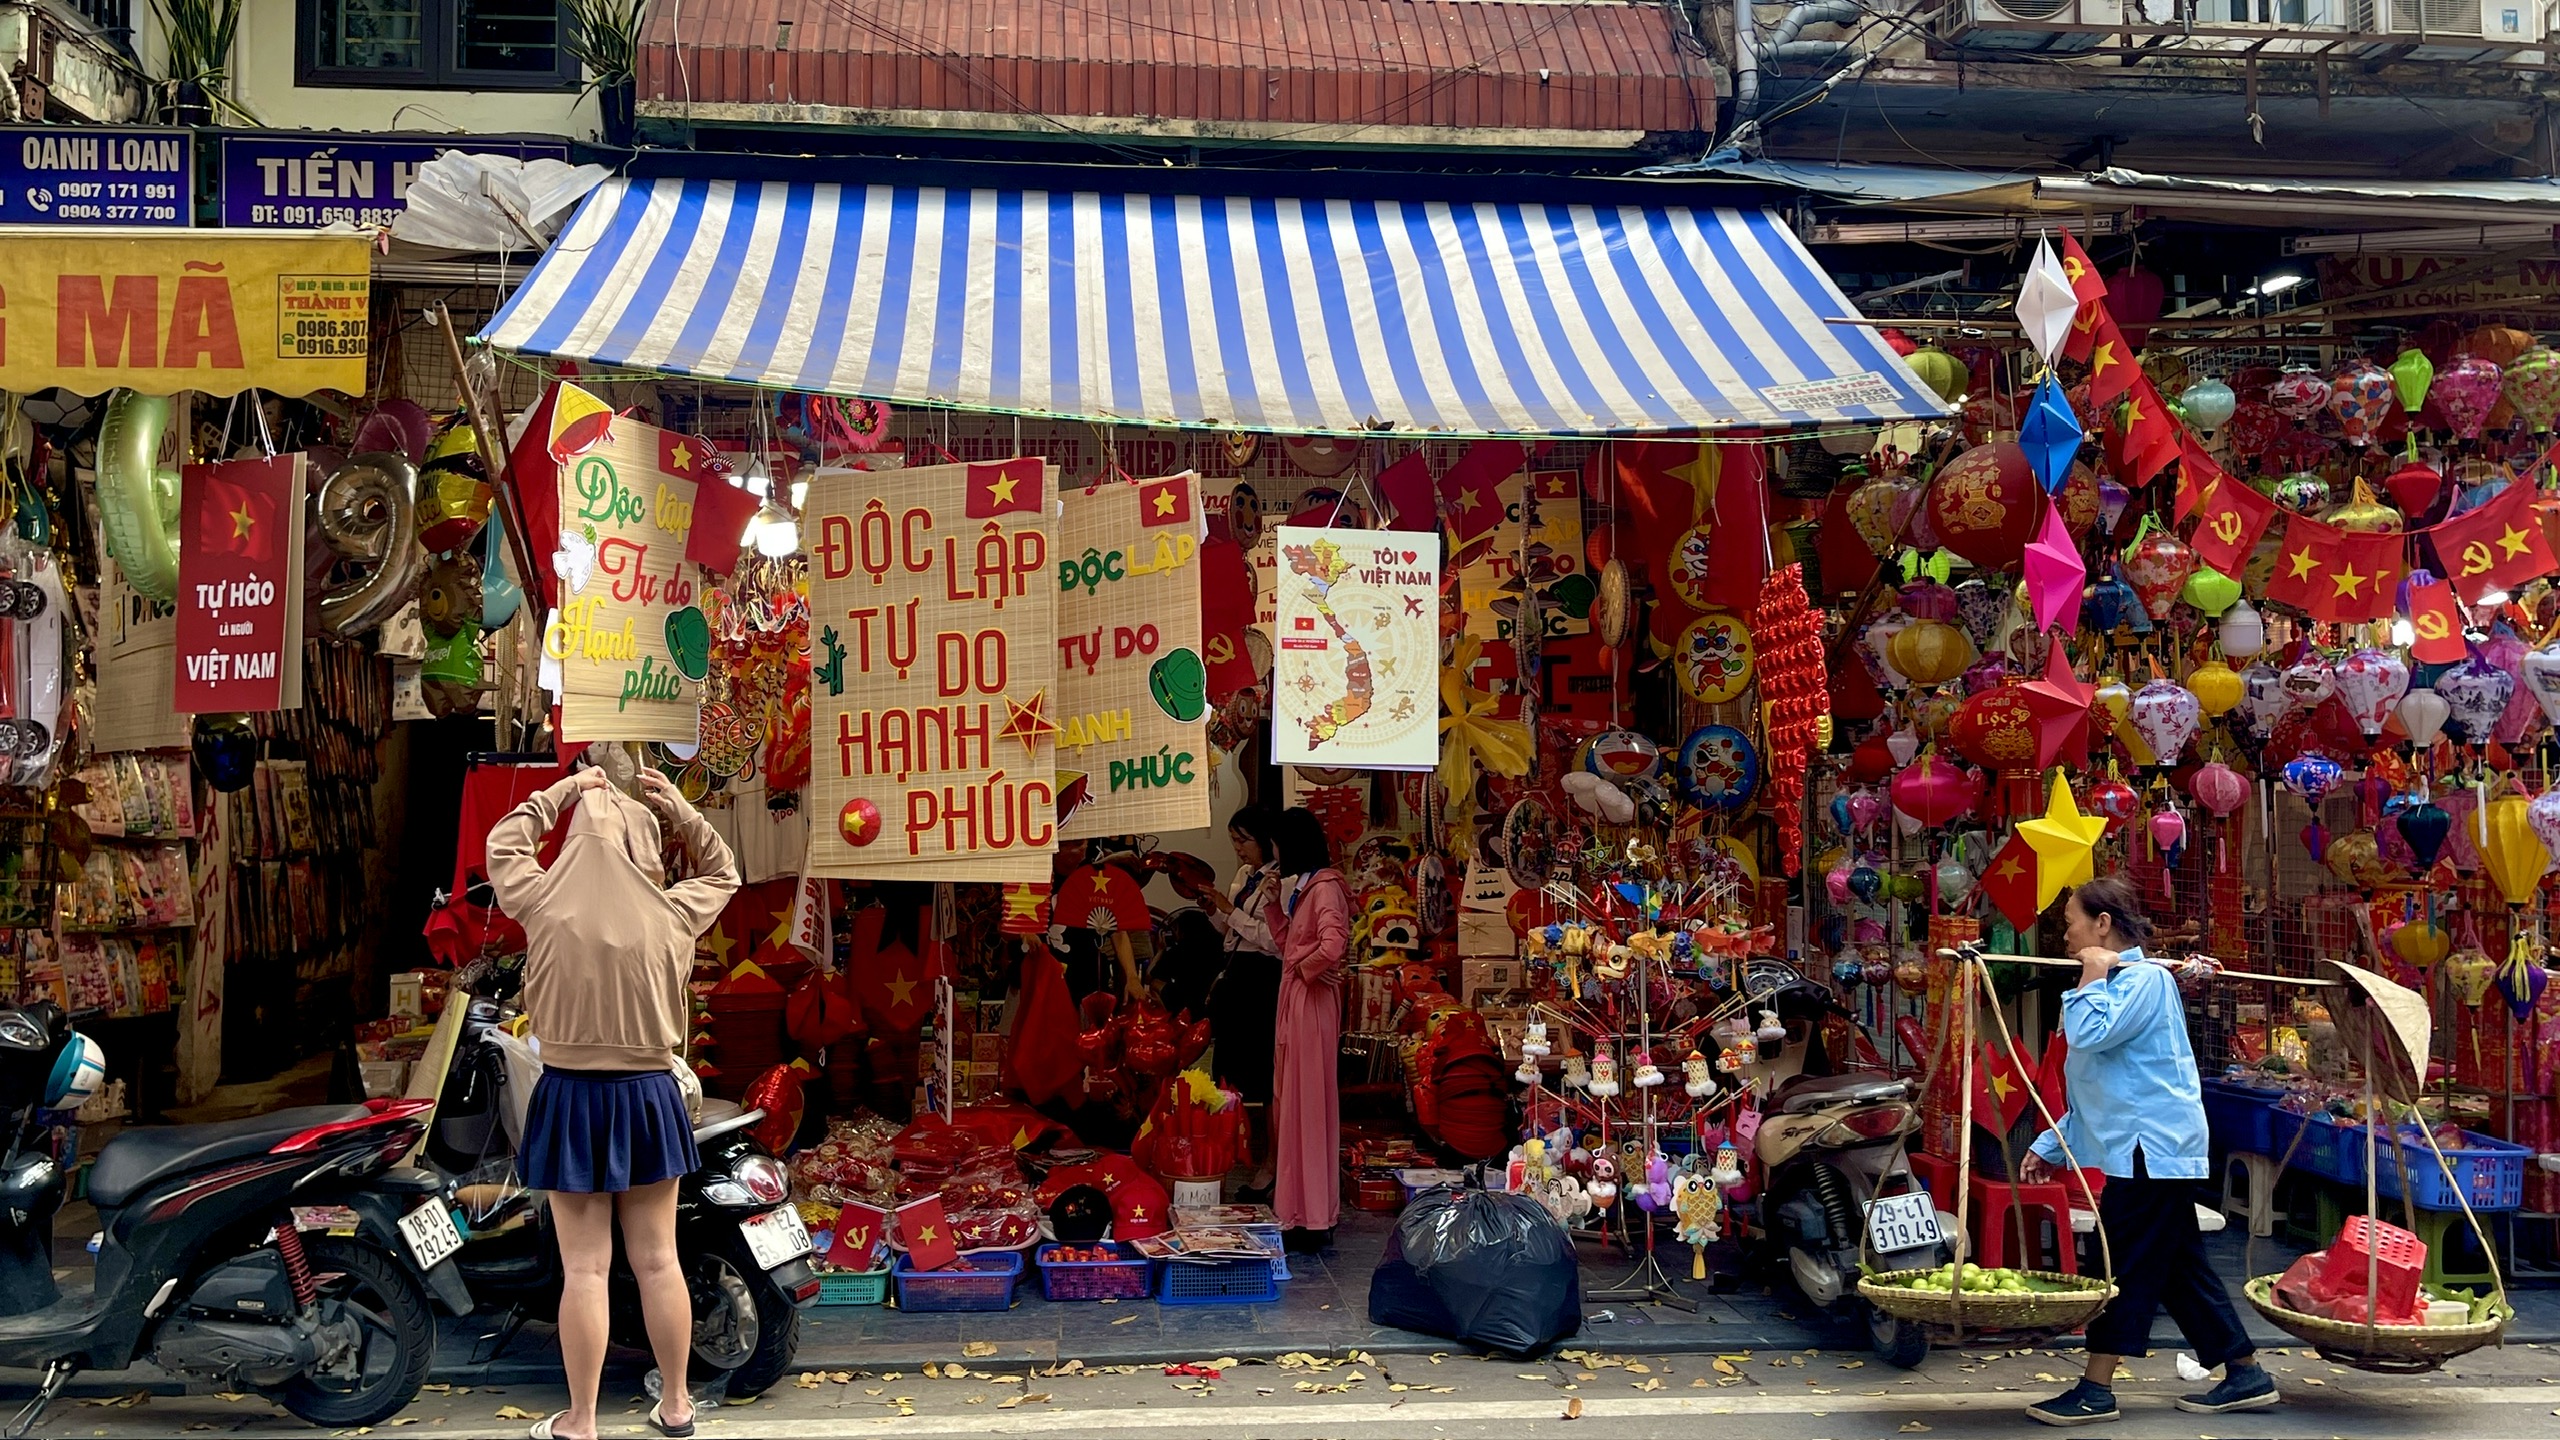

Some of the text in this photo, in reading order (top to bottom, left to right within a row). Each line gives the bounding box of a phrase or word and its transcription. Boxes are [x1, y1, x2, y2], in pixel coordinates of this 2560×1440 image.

[23, 136, 179, 172] OANH LOAN
[257, 147, 374, 199] TIẾN
[58, 182, 175, 199] 0907 171 991
[58, 205, 175, 220] 0904 377 700
[252, 205, 278, 223] ĐT:
[56, 260, 245, 369] MÃ
[285, 293, 351, 310] THÀNH
[576, 456, 692, 544] Độc lập
[599, 538, 692, 607] Tự do
[814, 498, 1047, 610] ĐỘC LẬP
[1058, 529, 1195, 596] ĐỘC LẬP
[1373, 547, 1398, 565] TÔI
[196, 579, 227, 618] TỰ
[1359, 566, 1431, 588] VIỆT NAM
[219, 622, 229, 636] LÀ
[545, 595, 638, 665] Hạnh
[848, 595, 1008, 698] TỰ DO
[1058, 623, 1159, 676] TỰ DO
[186, 648, 276, 688] VIỆT NAM
[619, 655, 682, 712] phúc
[837, 703, 991, 784] HẠNH
[1109, 744, 1195, 793] PHÚC
[905, 769, 1053, 857] PHÚC
[409, 1204, 445, 1239] 18-D1
[1874, 1197, 1925, 1224] 29-C1
[415, 1223, 459, 1266] 792.45
[1876, 1219, 1938, 1249] 319.49
